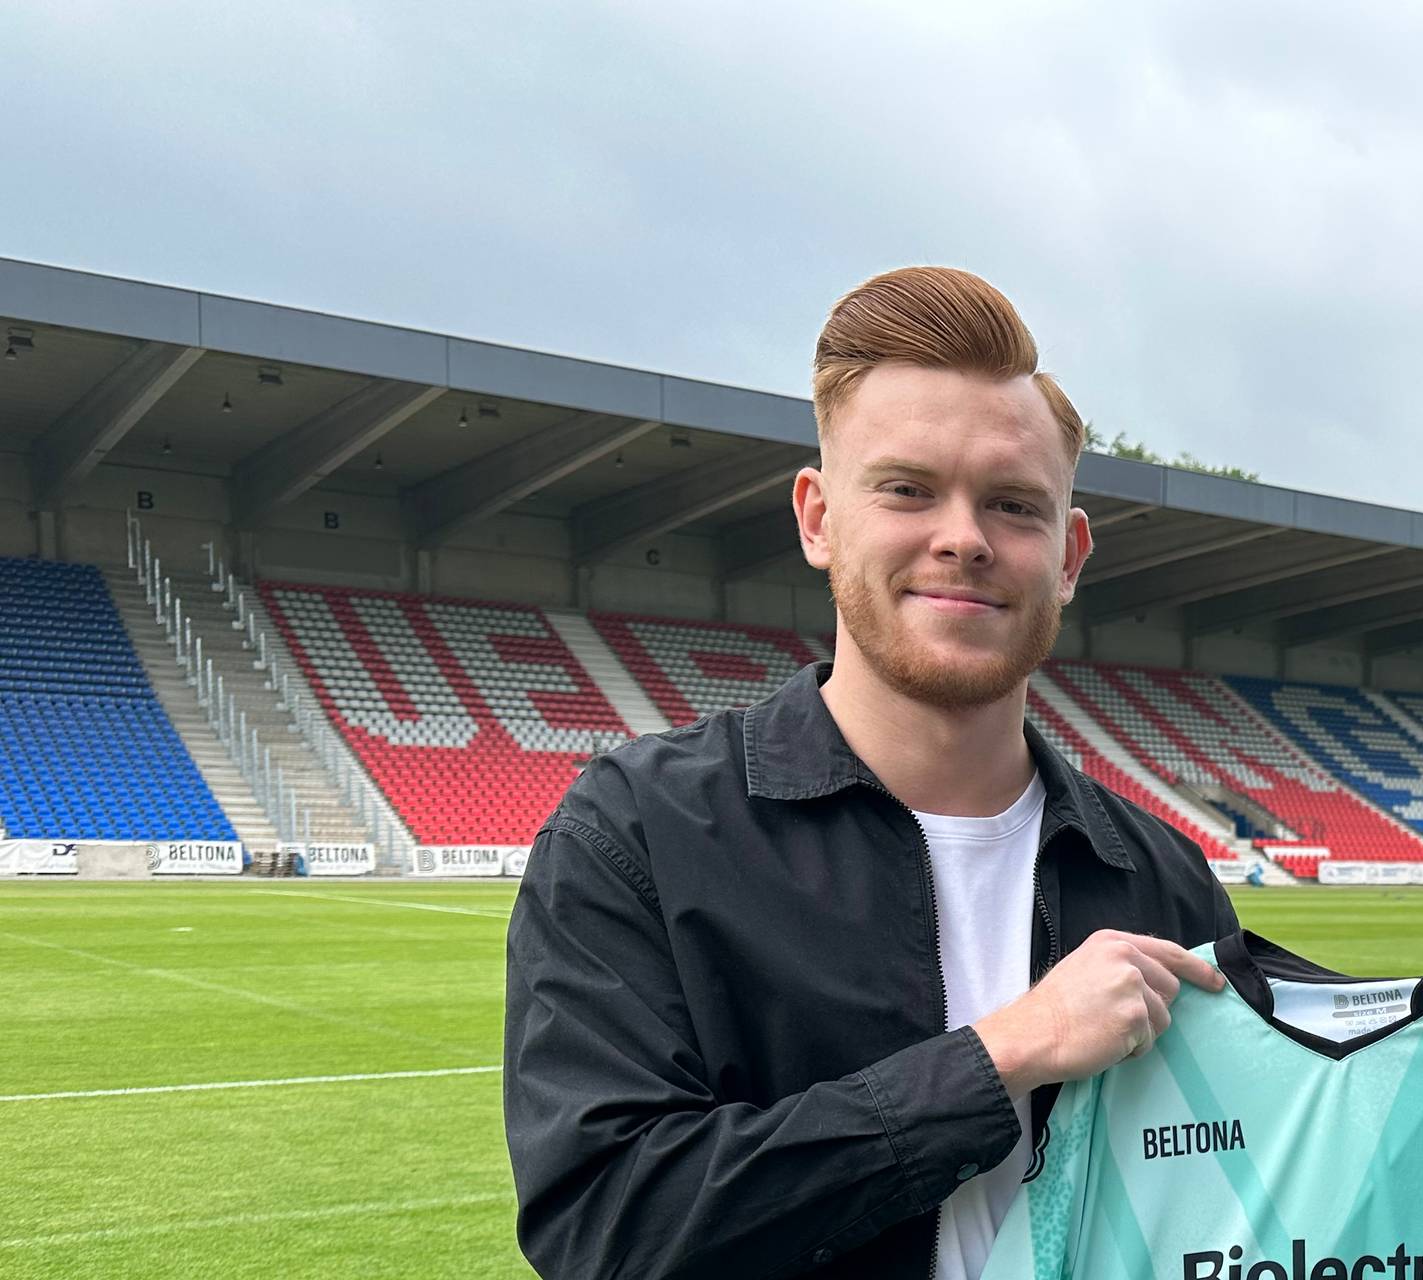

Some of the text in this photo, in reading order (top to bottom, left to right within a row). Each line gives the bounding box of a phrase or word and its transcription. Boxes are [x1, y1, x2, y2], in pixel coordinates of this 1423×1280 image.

[137, 491, 154, 510] B
[324, 512, 340, 530] B
[168, 844, 236, 861] BELTONA
[308, 847, 369, 863] BELTONA
[441, 849, 499, 864] BELTONA
[1352, 988, 1403, 1006] BELTONA
[1143, 1119, 1246, 1160] BELTONA
